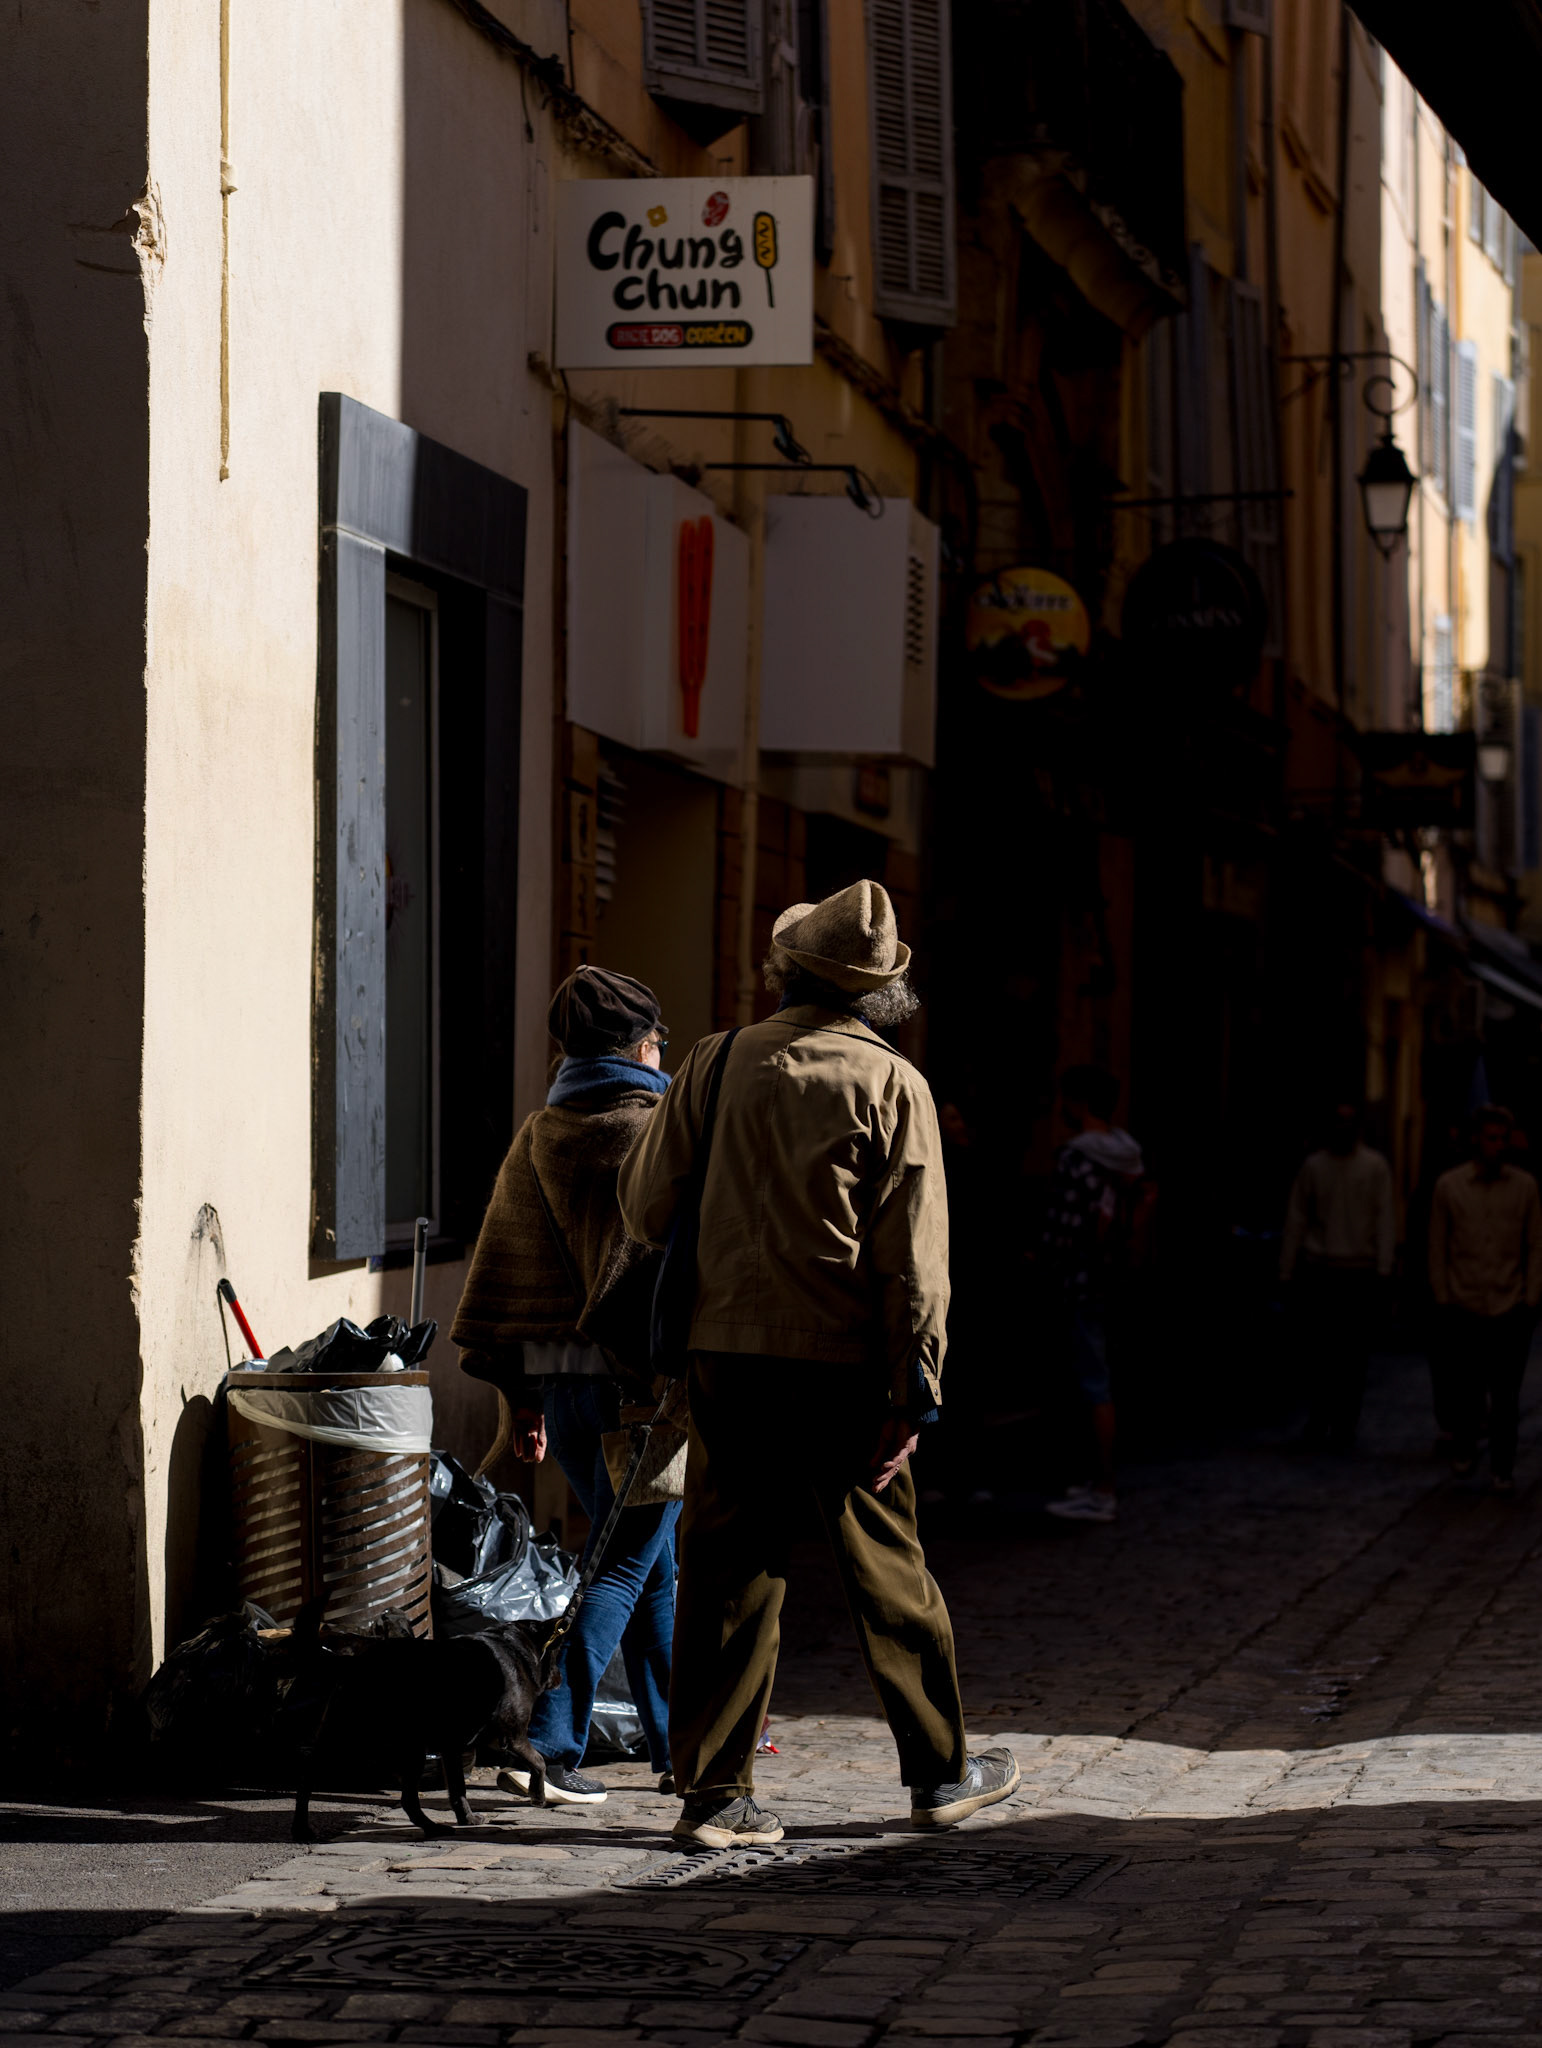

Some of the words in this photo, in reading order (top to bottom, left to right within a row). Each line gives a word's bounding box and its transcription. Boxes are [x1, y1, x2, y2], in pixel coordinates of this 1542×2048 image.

[588, 212, 743, 269] Chung
[615, 269, 740, 309] chun
[651, 326, 680, 343] DOG
